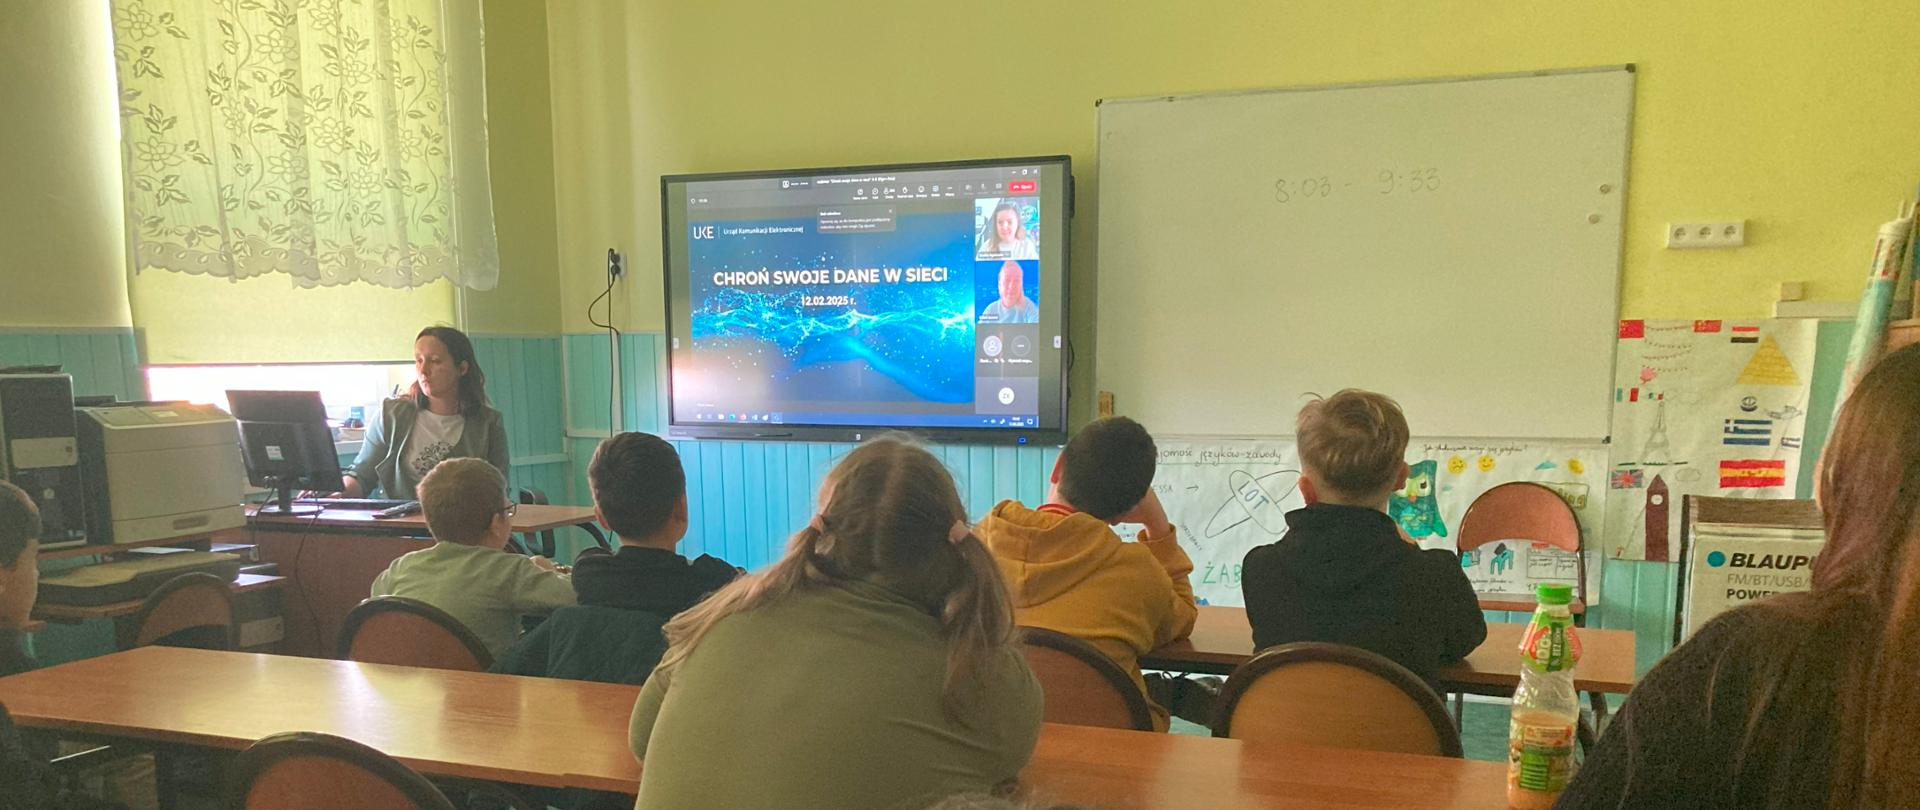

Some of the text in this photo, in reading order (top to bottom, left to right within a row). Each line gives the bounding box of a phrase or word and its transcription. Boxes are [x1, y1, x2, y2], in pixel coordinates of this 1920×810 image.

[1275, 176, 1331, 203] 8:03
[1379, 168, 1441, 194] 9:33
[693, 226, 714, 239] UKE
[713, 266, 948, 286] CHROŃ SWOJE DANE W SIECI
[801, 295, 848, 306] 12.02.2025
[1237, 480, 1270, 512] LOT
[1726, 588, 1779, 600] POWE
